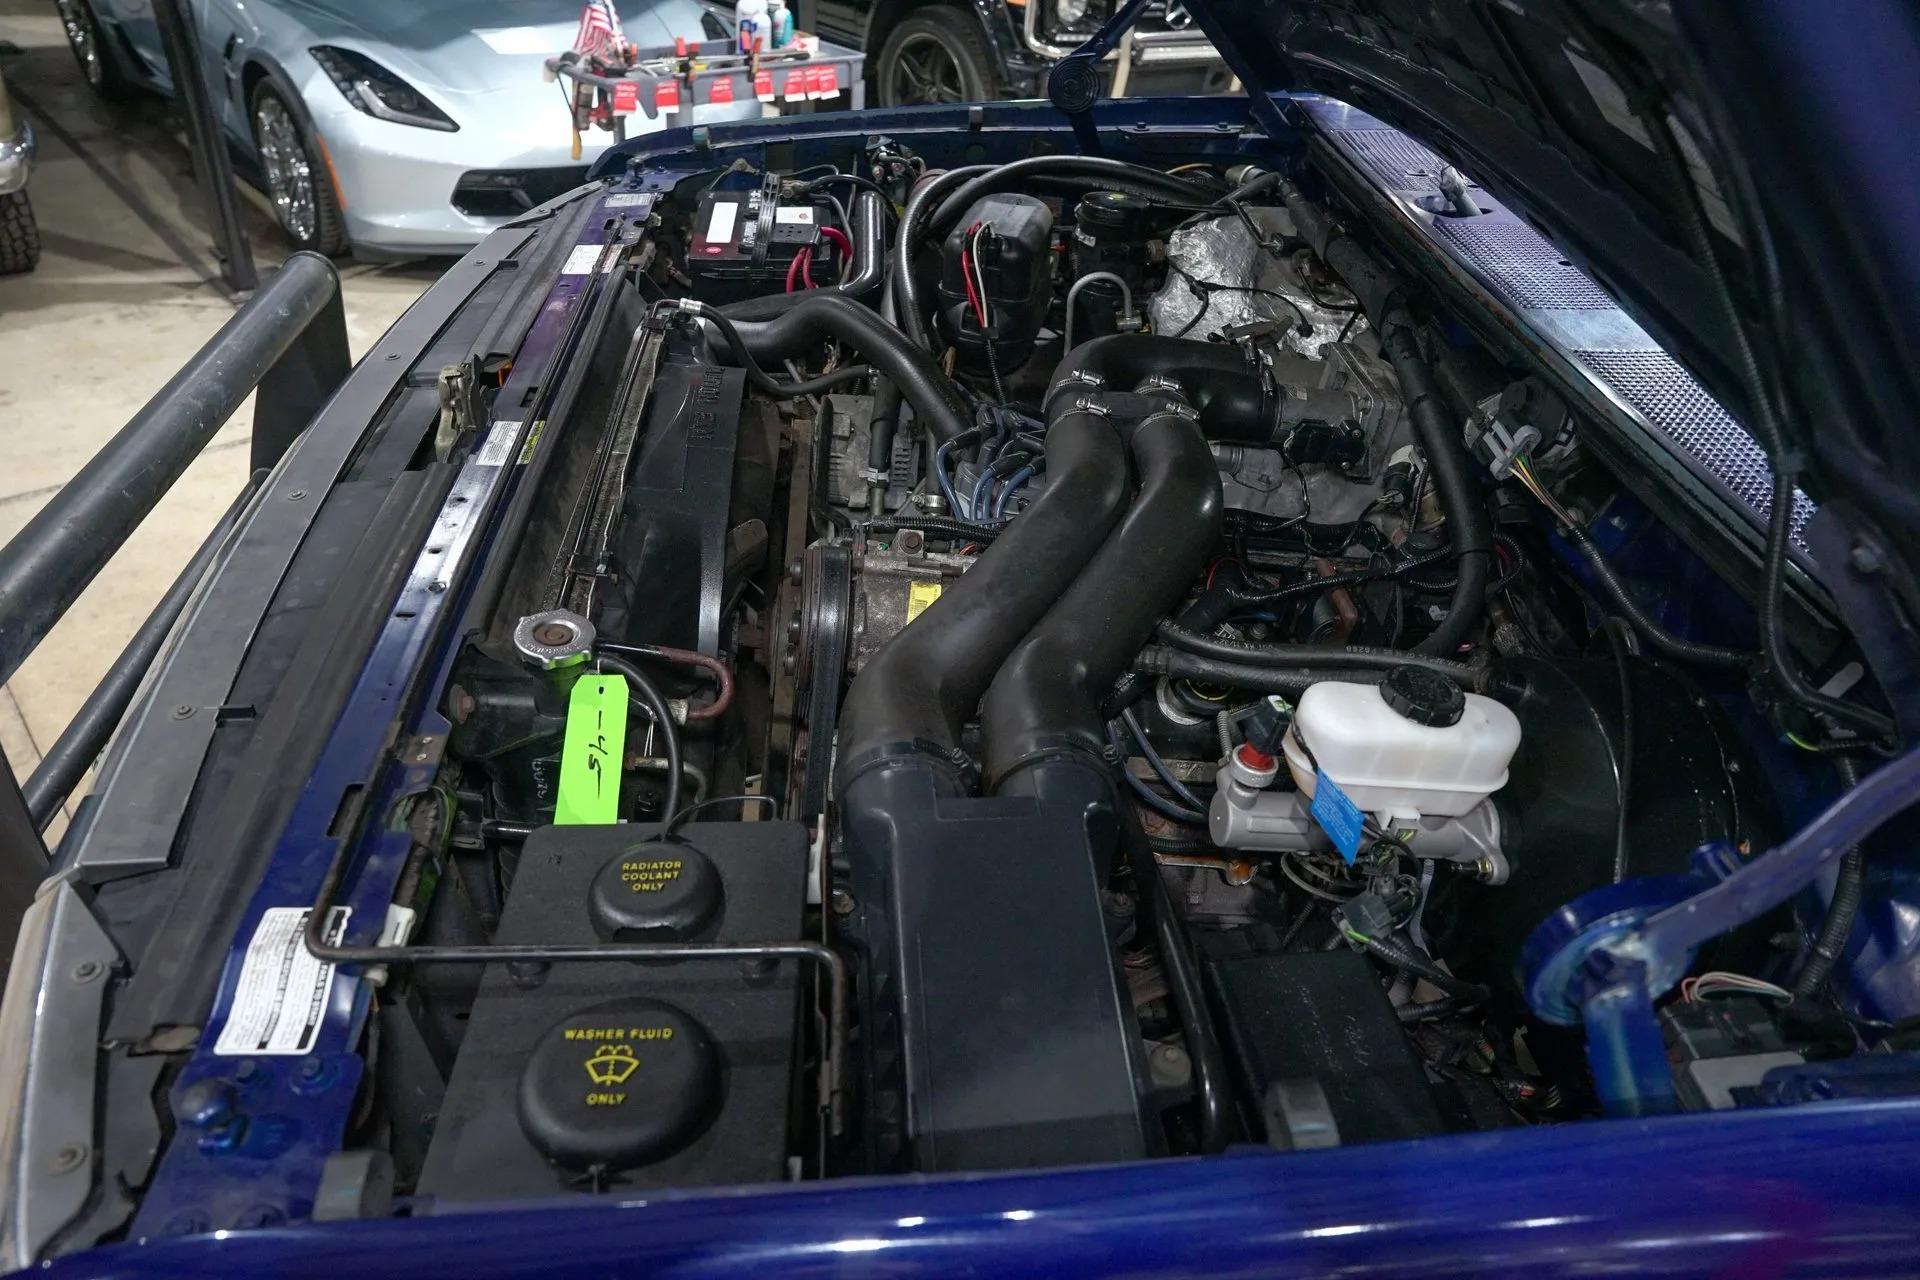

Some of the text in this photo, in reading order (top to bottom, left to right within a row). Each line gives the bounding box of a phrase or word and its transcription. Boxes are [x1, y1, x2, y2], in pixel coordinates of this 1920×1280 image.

[622, 860, 682, 871] RADIATOR
[621, 870, 680, 881] COOLANT
[632, 882, 665, 892] ONLY
[564, 1027, 673, 1040] WASHER FLUID
[586, 1092, 626, 1106] ONLY
